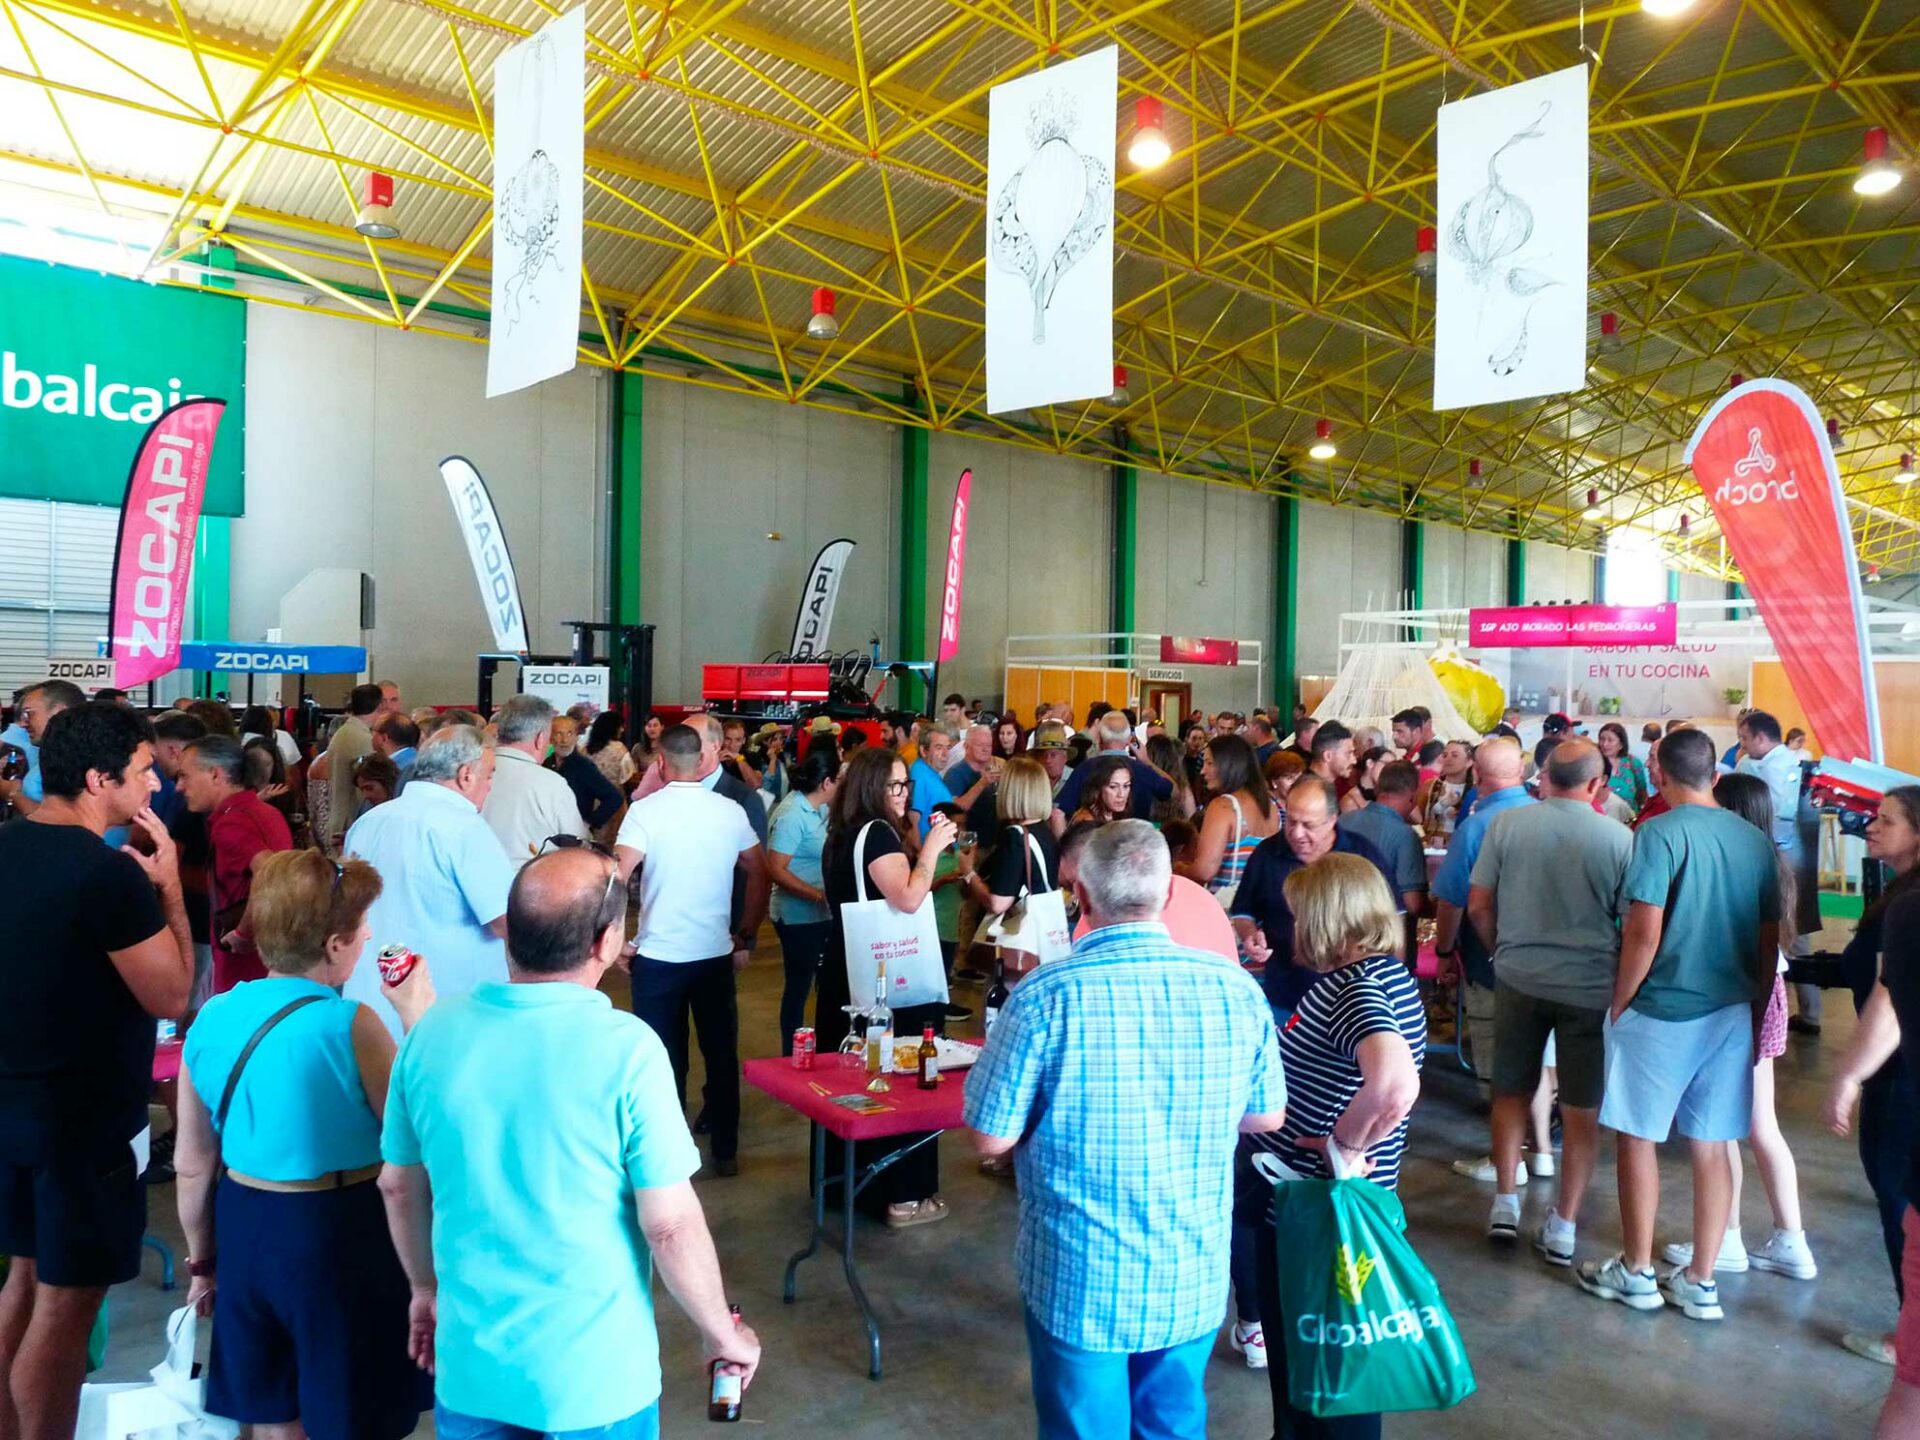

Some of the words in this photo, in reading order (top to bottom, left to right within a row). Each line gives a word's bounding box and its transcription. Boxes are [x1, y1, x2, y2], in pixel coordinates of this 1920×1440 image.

[129, 433, 193, 658] ZOCAPI
[943, 497, 965, 642] ZOCAPI
[798, 566, 833, 660] OCAPI
[1521, 622, 1563, 631] MORADO
[1566, 622, 1585, 631] LAS
[215, 652, 310, 670] ZOCAPI
[49, 664, 111, 677] ZOCAPI
[1149, 670, 1182, 680] SERVICIOS
[1589, 665, 1609, 678] EN
[1615, 665, 1637, 678] TU
[1641, 665, 1710, 678] COCINA
[530, 674, 603, 685] ZOCAPI
